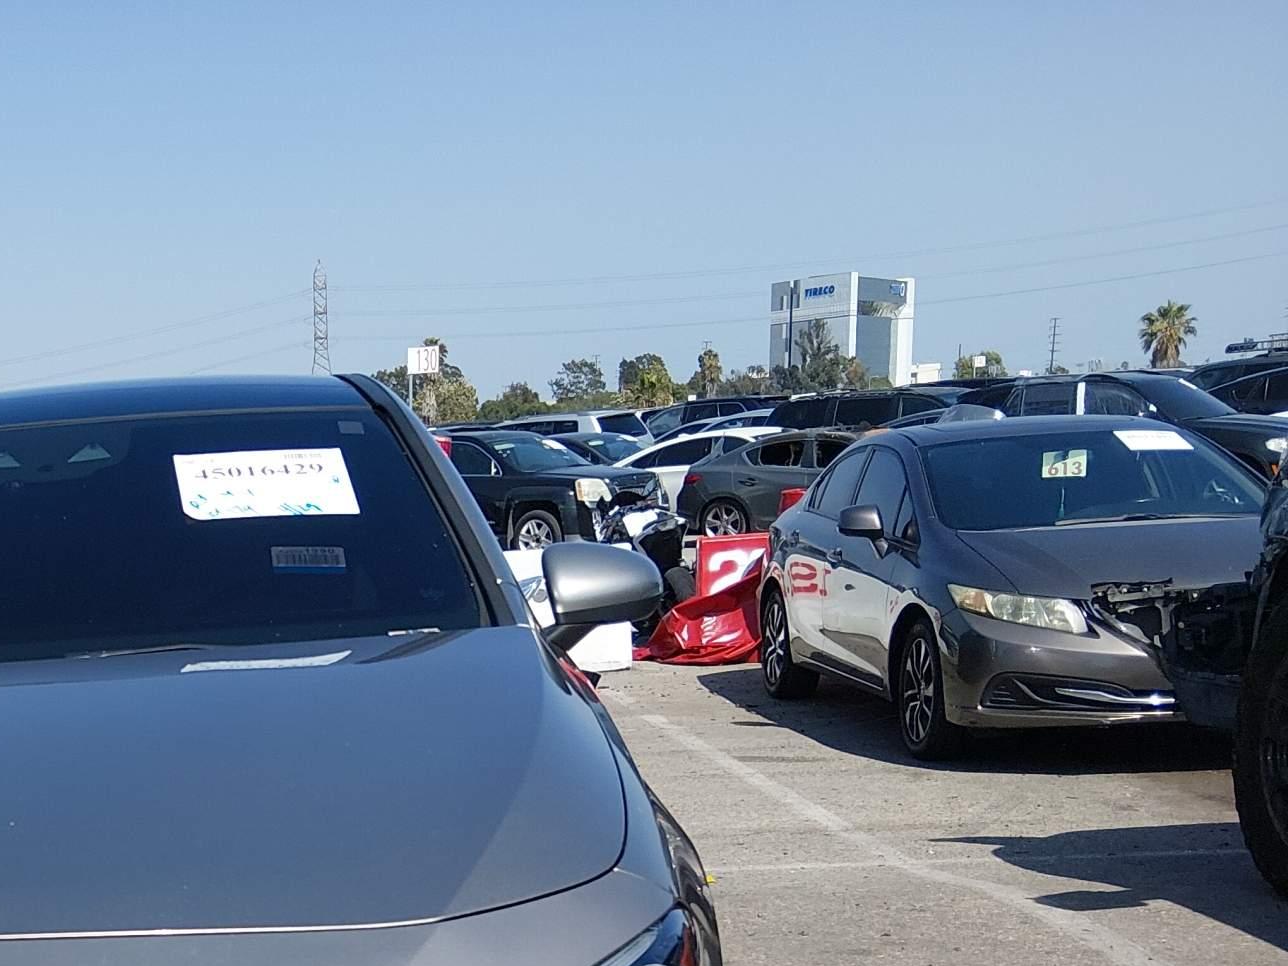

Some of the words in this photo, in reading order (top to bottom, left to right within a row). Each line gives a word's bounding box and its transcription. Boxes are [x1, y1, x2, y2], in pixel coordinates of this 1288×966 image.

[804, 285, 835, 298] TIRECO
[416, 348, 438, 372] 130
[194, 462, 324, 480] 45016429
[1047, 461, 1083, 476] 613
